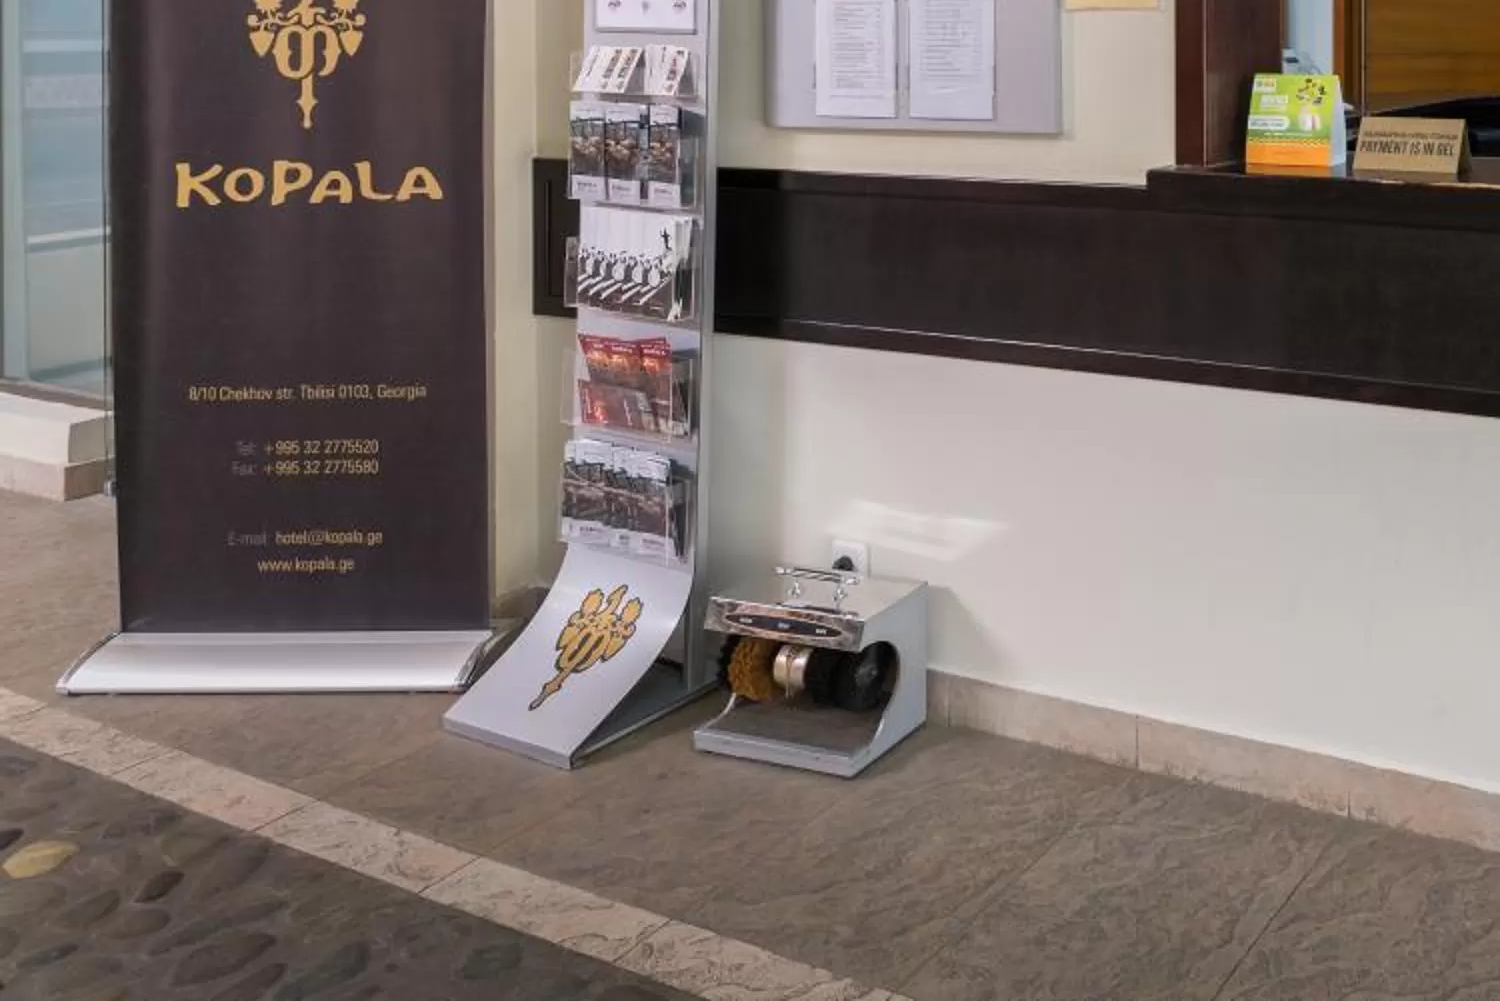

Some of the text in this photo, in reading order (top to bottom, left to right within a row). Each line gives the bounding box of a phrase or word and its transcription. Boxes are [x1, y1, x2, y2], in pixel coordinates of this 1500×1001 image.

[175, 159, 444, 208] KOPALA
[188, 386, 217, 401] 8/10
[300, 384, 336, 400] Tbilisi
[338, 383, 373, 400] 0103,
[376, 383, 427, 402] Georgia
